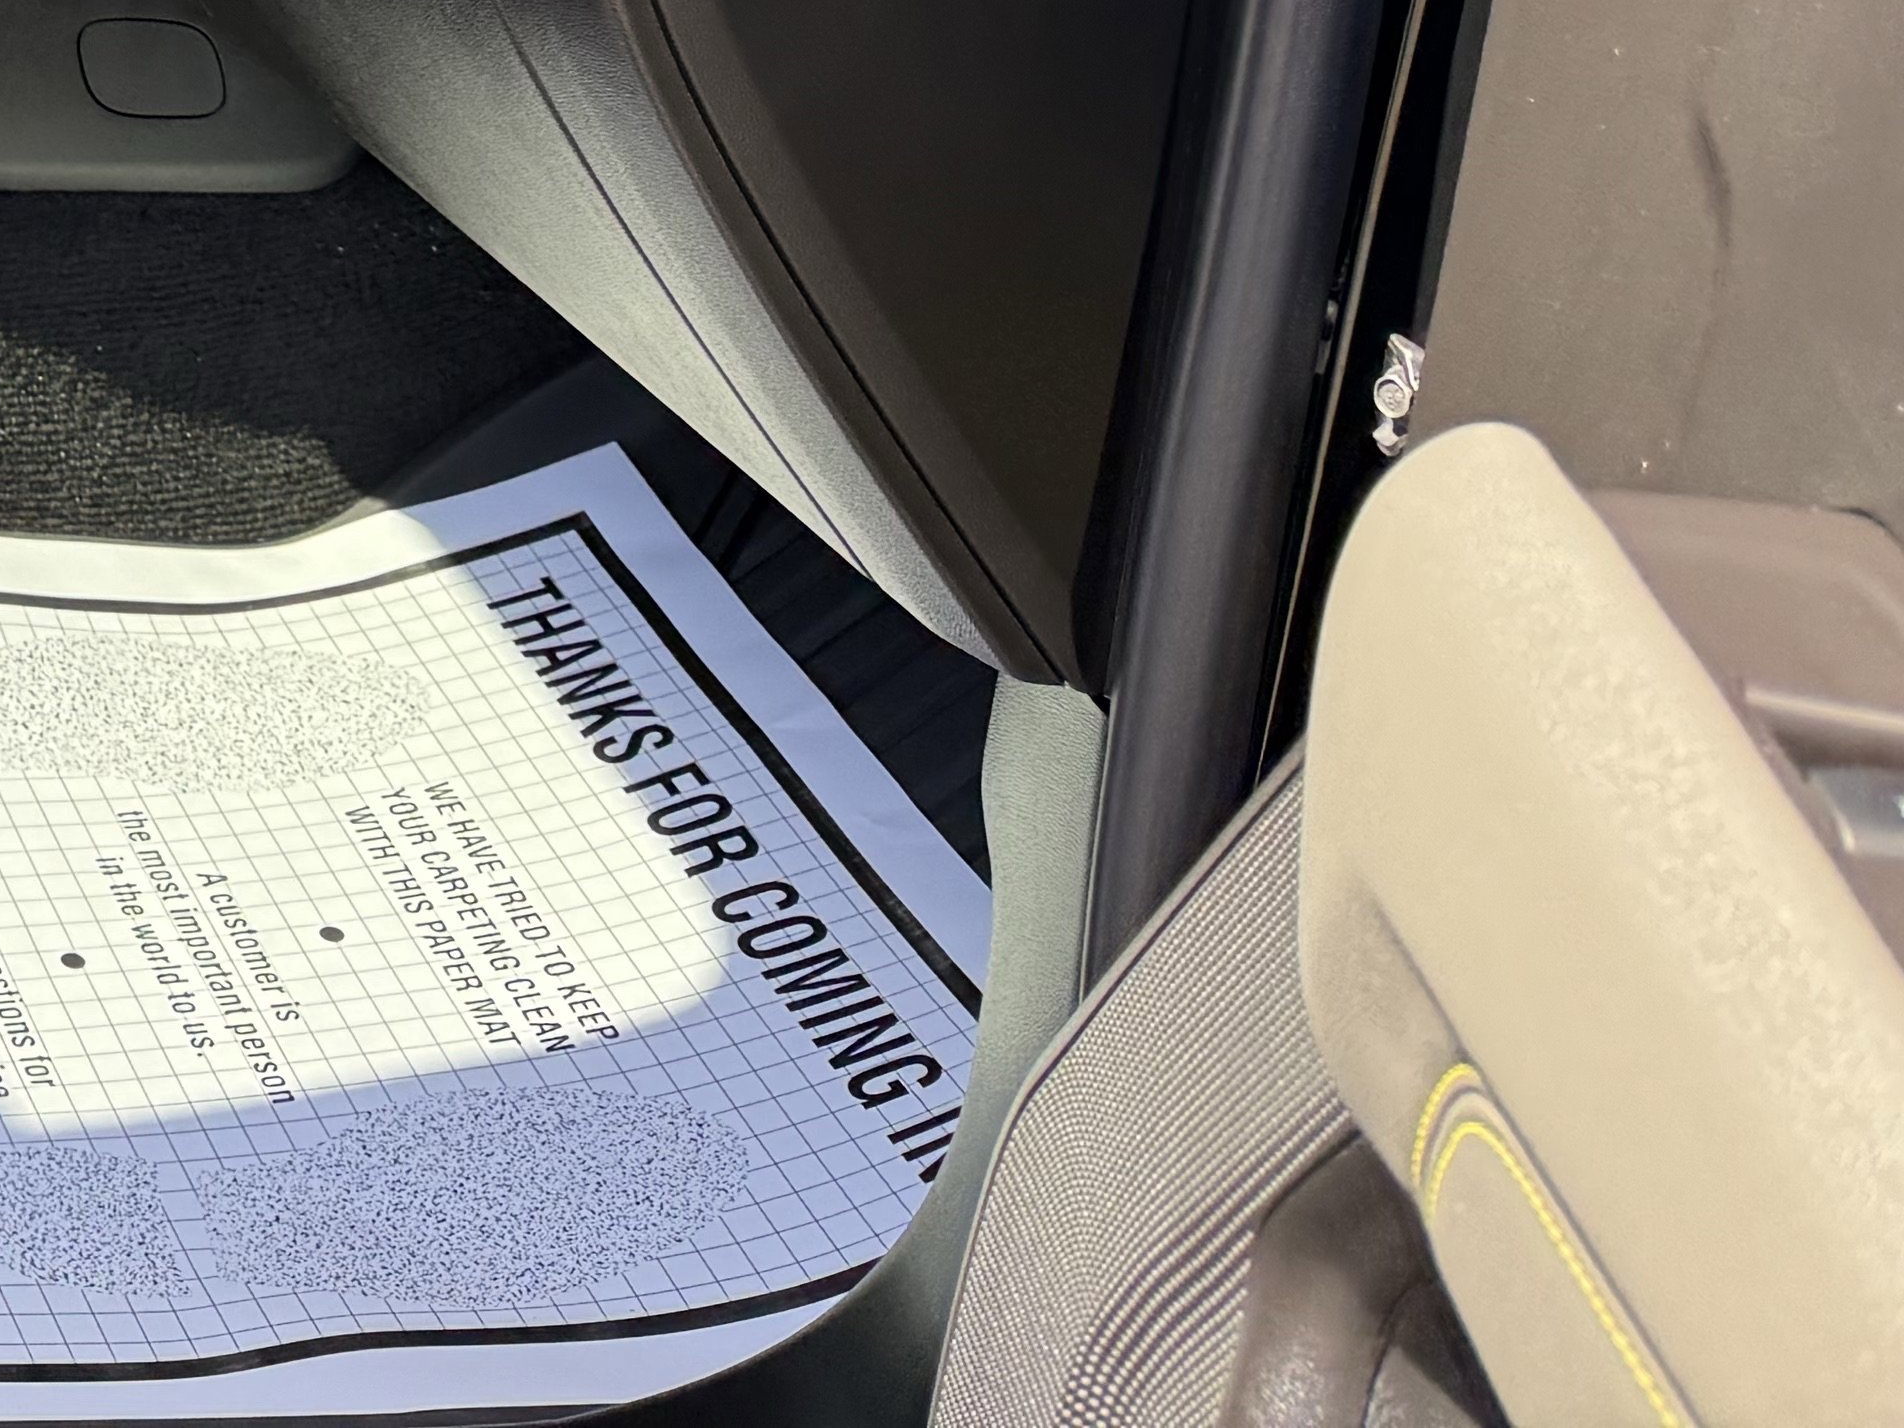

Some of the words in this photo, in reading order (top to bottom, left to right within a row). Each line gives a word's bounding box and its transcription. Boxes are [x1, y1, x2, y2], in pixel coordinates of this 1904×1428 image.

[195, 873, 228, 887] A
[210, 893, 286, 993] customer
[344, 806, 400, 860] WITH
[382, 863, 434, 913] THIS
[415, 920, 483, 991] PAPER
[464, 997, 521, 1044] MAT
[381, 787, 437, 845] YOUR
[421, 851, 521, 971] CARPETING
[504, 978, 576, 1053] CLEAN
[424, 781, 466, 815] WE
[447, 818, 506, 874] HAVE
[488, 876, 551, 940] TRIED
[535, 945, 575, 976] TO
[557, 983, 620, 1040] KEEP
[486, 576, 675, 764] THANKS
[623, 762, 760, 878] FOR
[711, 881, 943, 1109] COMING
[96, 857, 124, 876] in
[110, 883, 144, 916] the
[131, 923, 189, 985] world
[167, 992, 196, 1013] to
[183, 1022, 215, 1057] us.
[117, 810, 151, 842] the
[136, 850, 189, 901] most
[169, 907, 252, 1015] important
[224, 1023, 295, 1104] person
[270, 1001, 300, 1021] is
[20, 1055, 56, 1087] for
